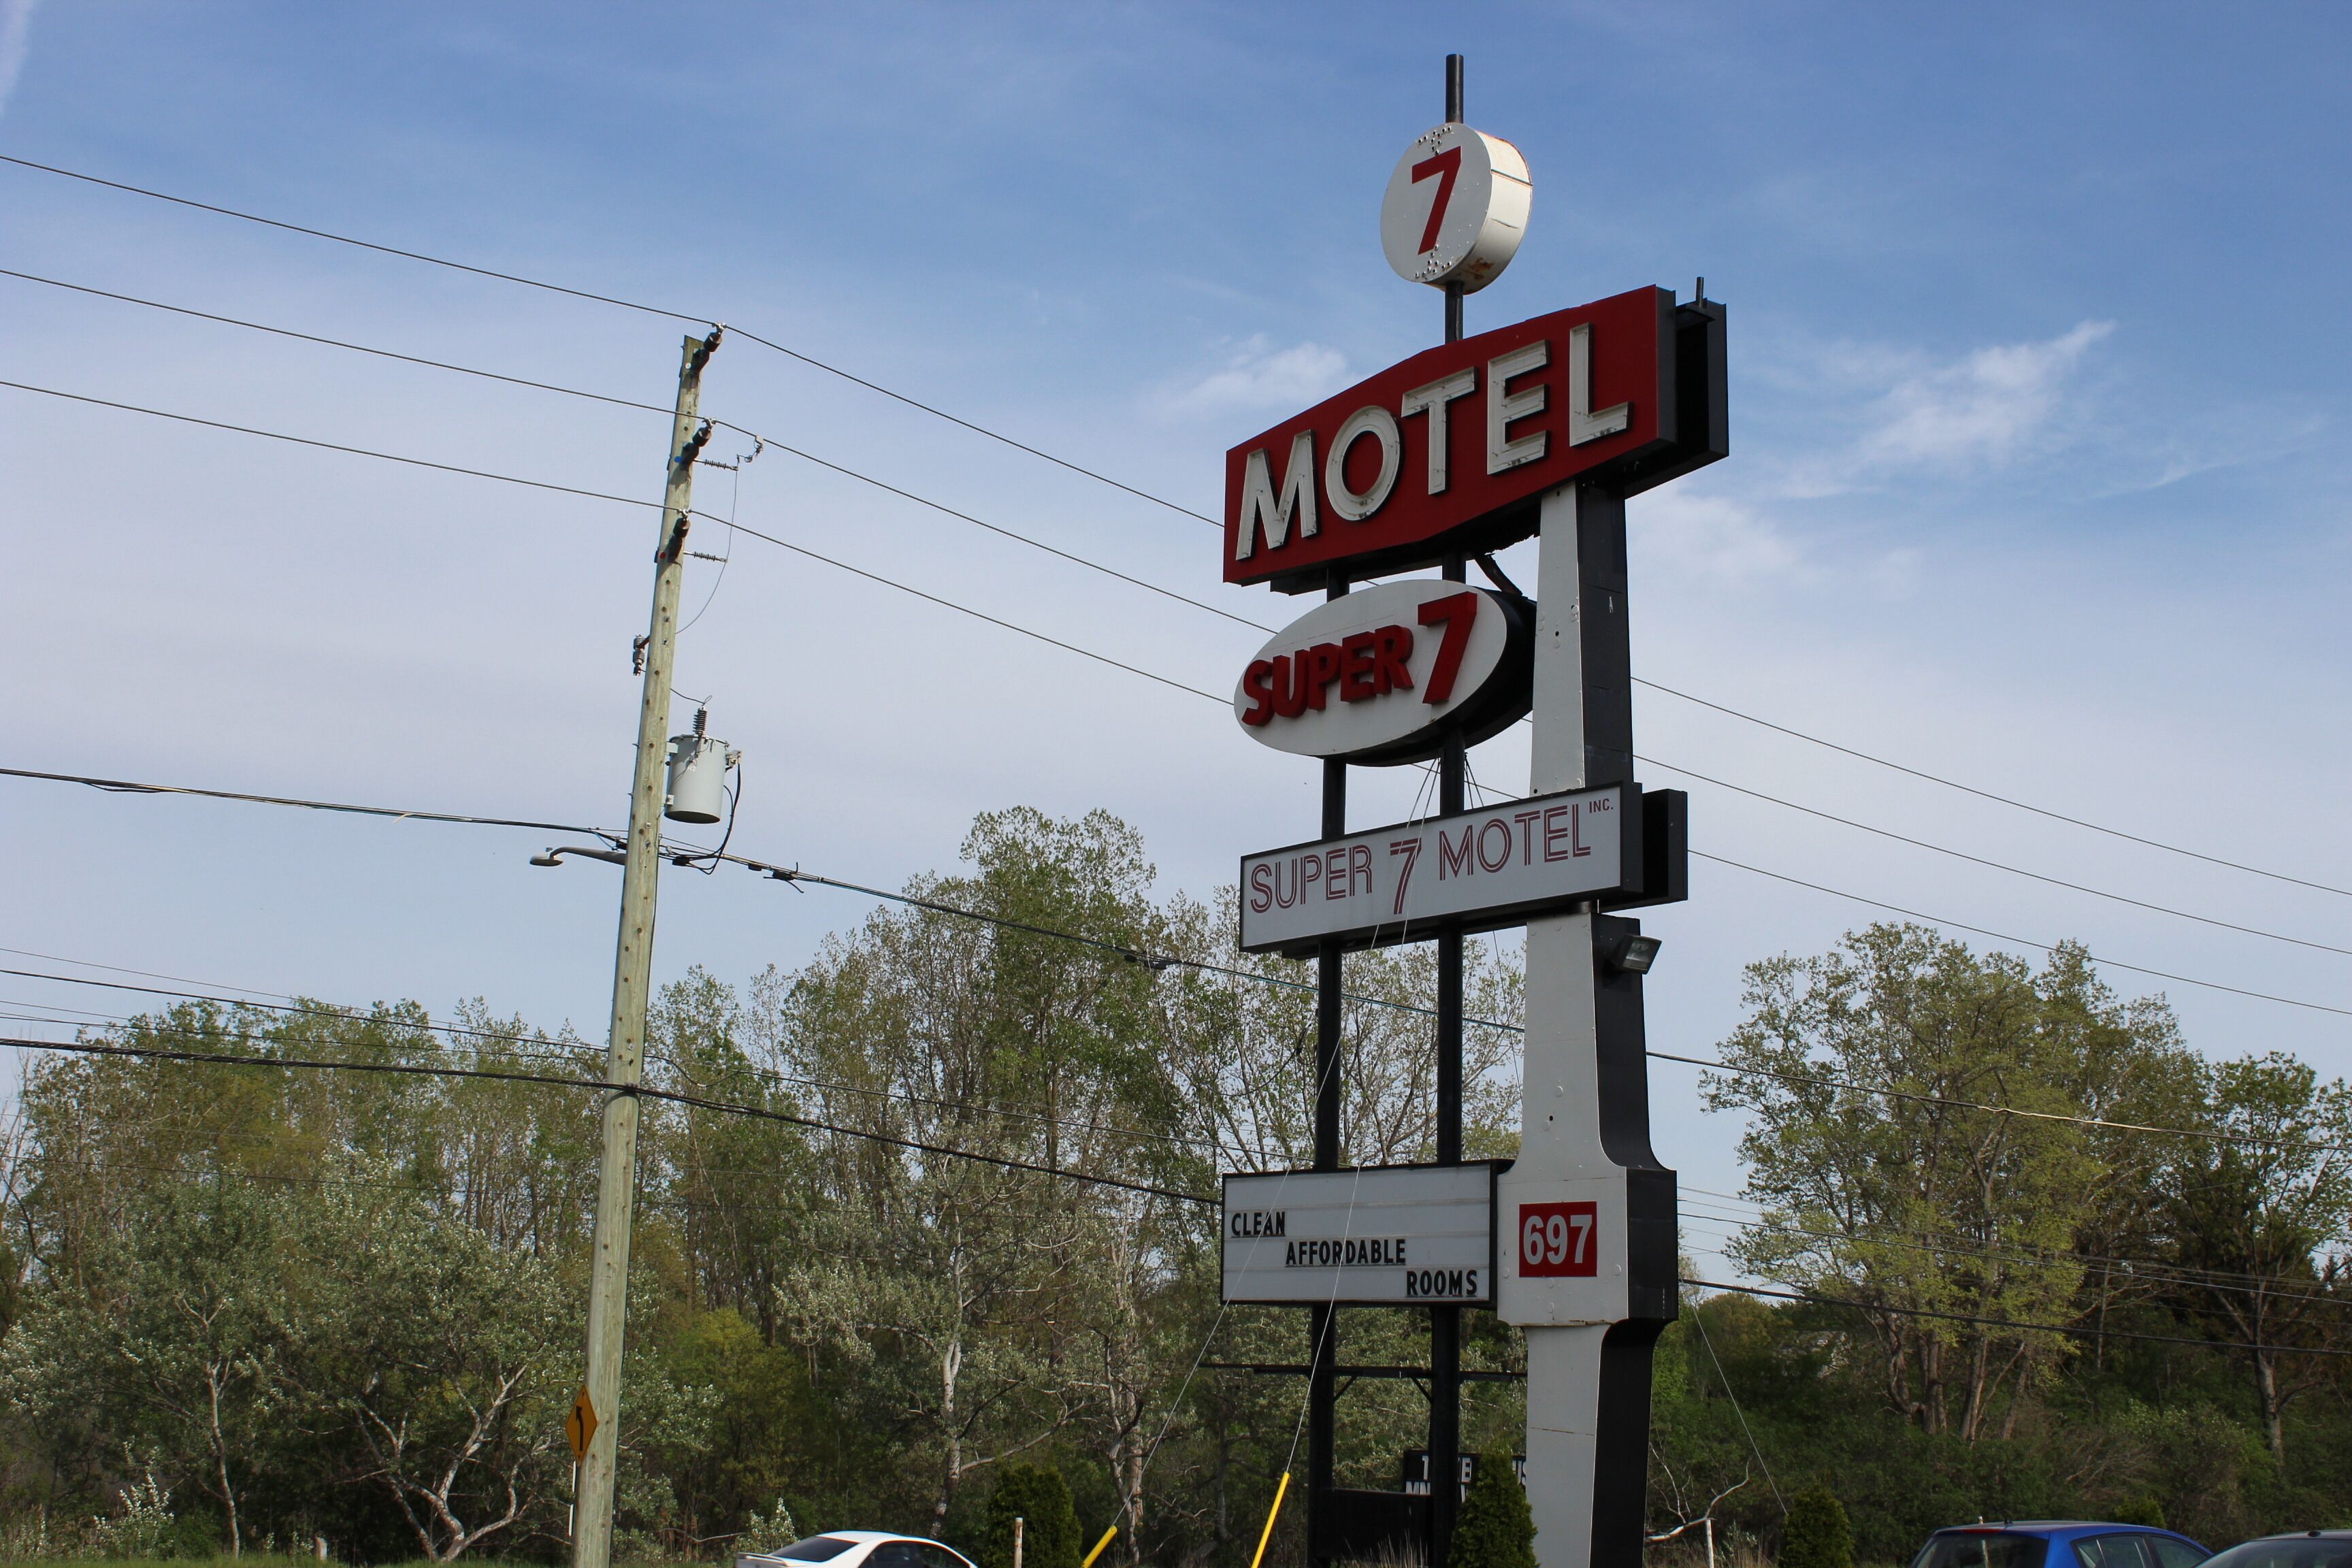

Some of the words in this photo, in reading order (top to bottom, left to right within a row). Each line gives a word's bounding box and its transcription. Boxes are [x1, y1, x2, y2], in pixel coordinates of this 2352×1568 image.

[1411, 145, 1462, 255] 7
[1235, 322, 1631, 561] MOTEL
[1241, 624, 1415, 727] SUPER
[1417, 591, 1477, 705] 7
[1250, 844, 1373, 914] SUPER
[1390, 837, 1422, 915] 7
[1439, 804, 1591, 881] MOTEL
[1589, 798, 1614, 814] INC.
[1231, 1211, 1286, 1237] CLEAN
[1286, 1239, 1406, 1265] AFFORDABLE
[1522, 1214, 1593, 1266] 697
[1406, 1269, 1477, 1296] ROOMS
